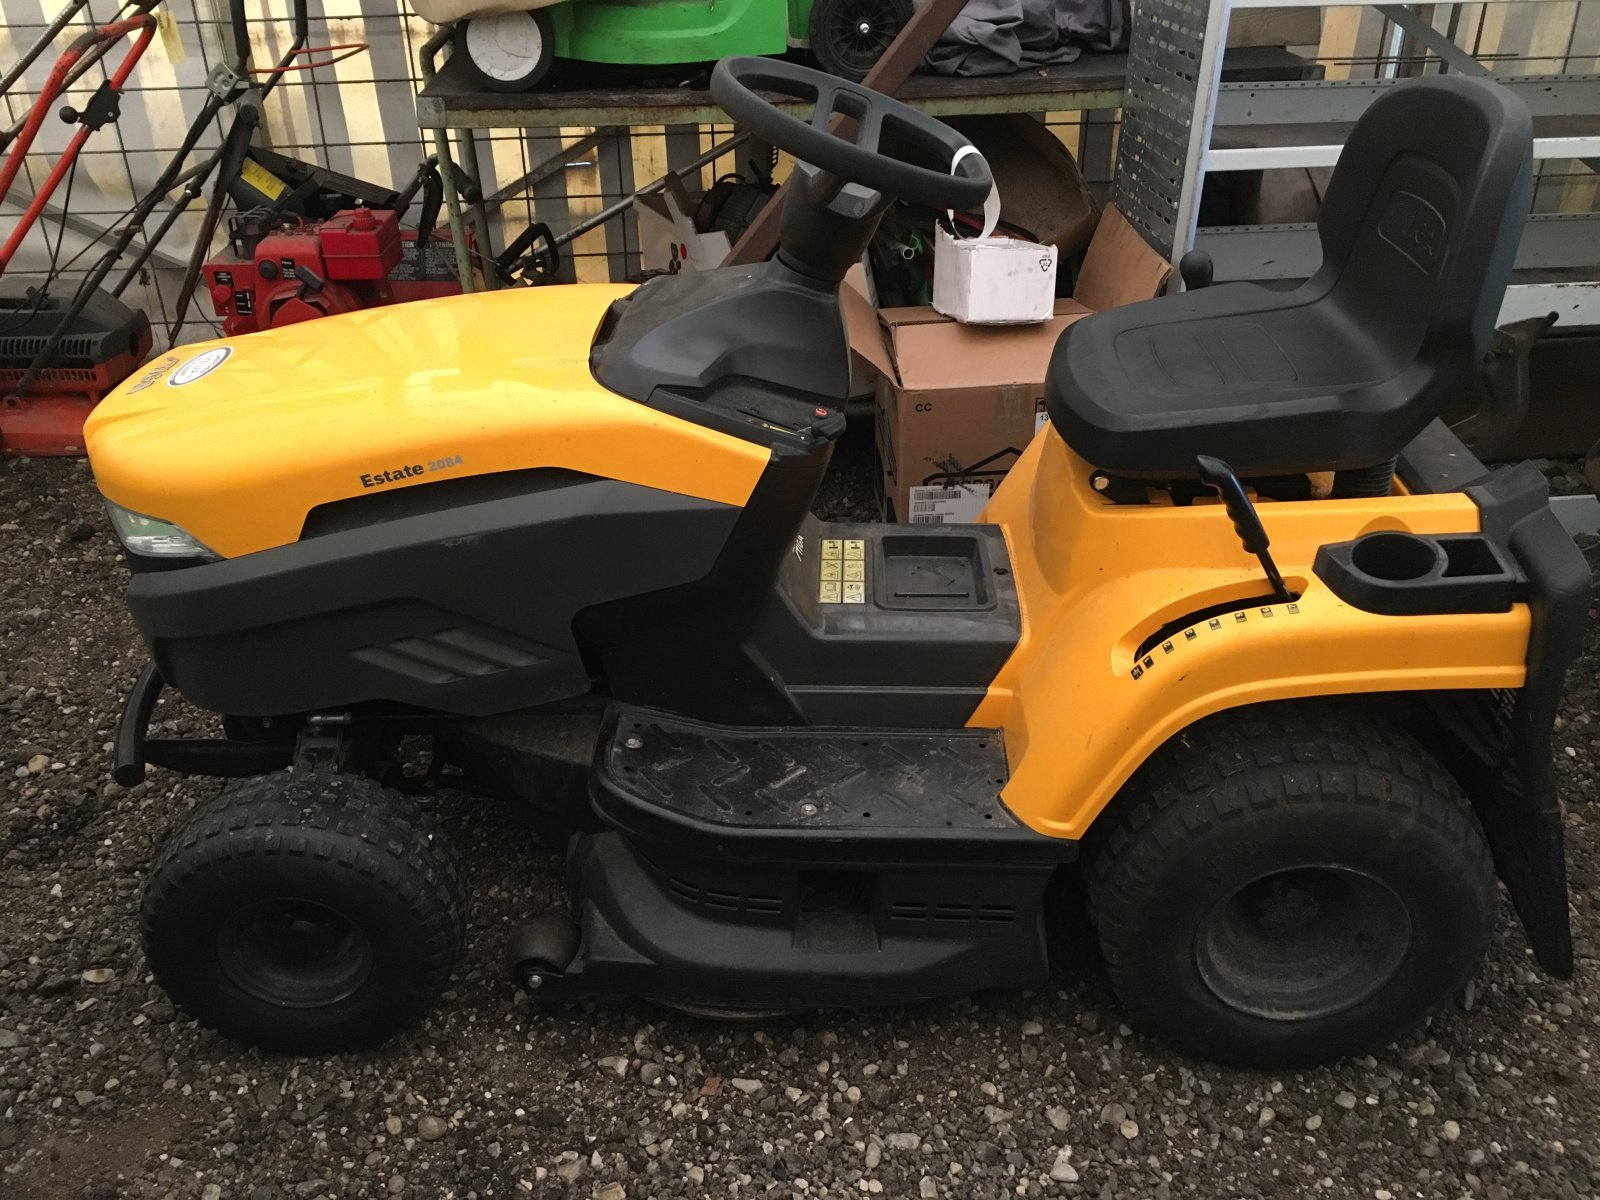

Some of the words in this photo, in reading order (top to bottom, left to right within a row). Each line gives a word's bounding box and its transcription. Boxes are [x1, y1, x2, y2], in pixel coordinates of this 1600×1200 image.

[915, 402, 933, 413] CC
[360, 464, 424, 488] Estate
[427, 454, 464, 472] 2084
